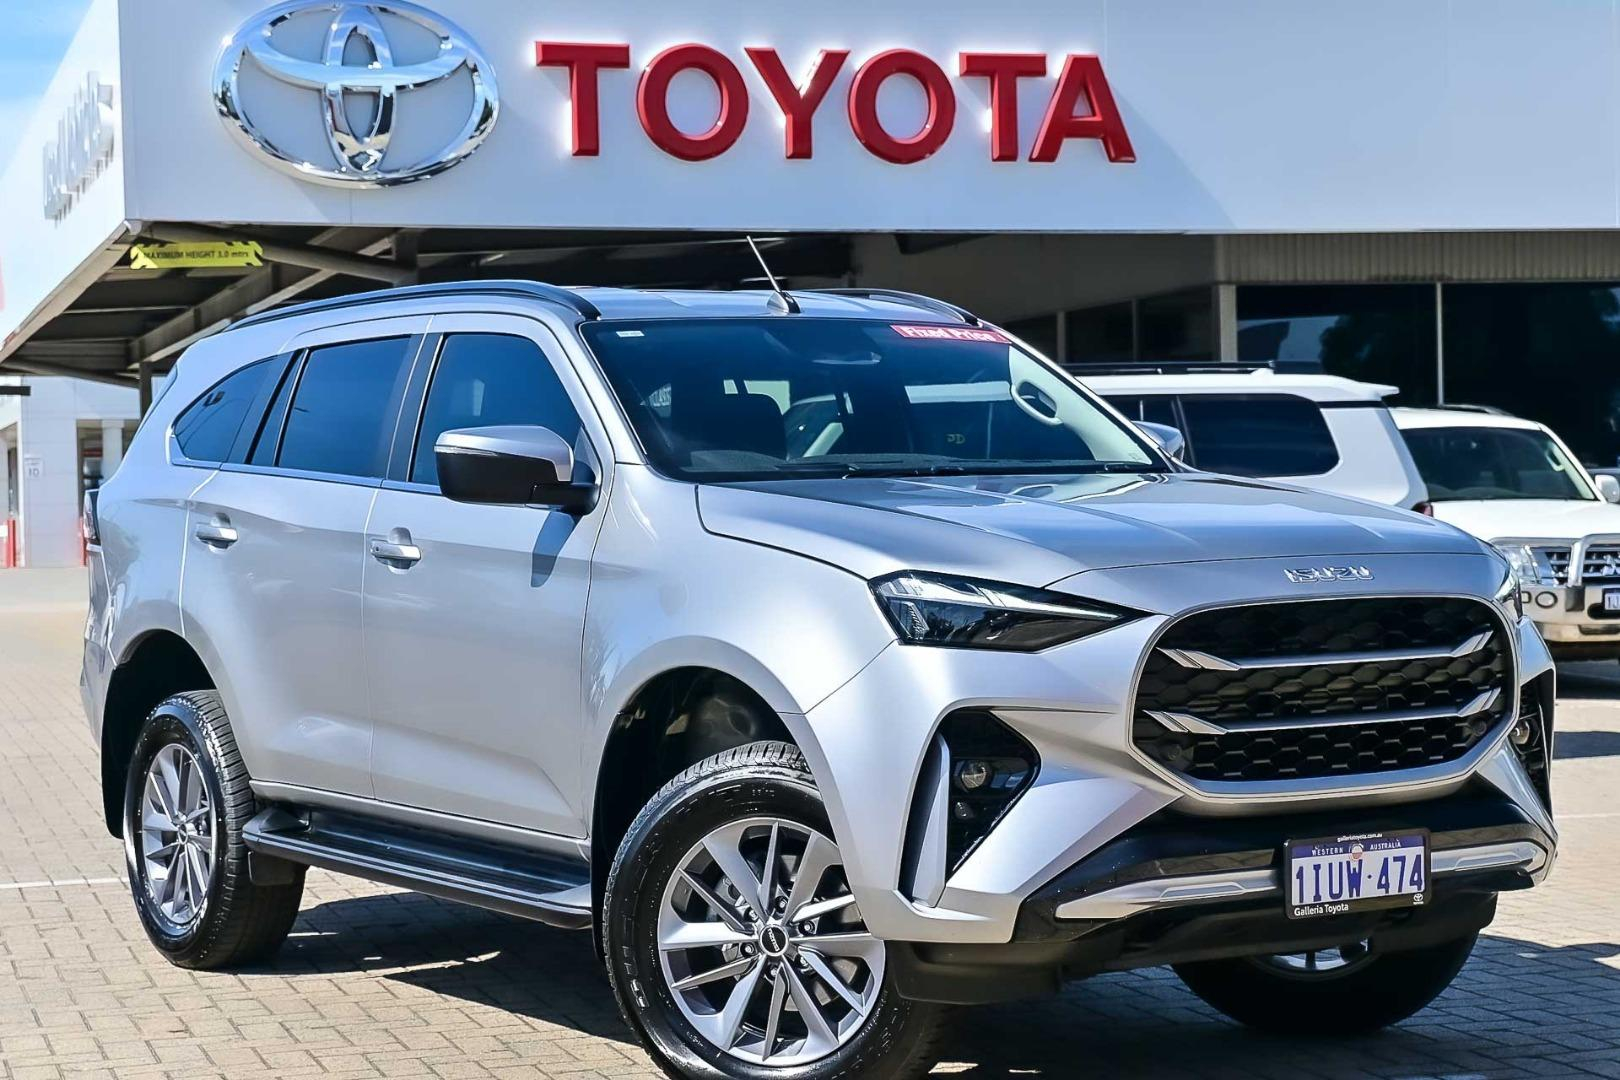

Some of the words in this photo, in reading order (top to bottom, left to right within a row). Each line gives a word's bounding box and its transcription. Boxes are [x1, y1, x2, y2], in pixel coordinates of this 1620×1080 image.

[535, 40, 1137, 164] TOYOTA
[902, 327, 951, 338] Fixed
[947, 329, 998, 341] Price
[1283, 566, 1374, 583] ISUZU
[1311, 847, 1344, 856] WESTERN
[1369, 840, 1402, 851] AUSTRALIA
[1294, 905, 1324, 917] Galleria
[1325, 903, 1349, 914] Toyota
